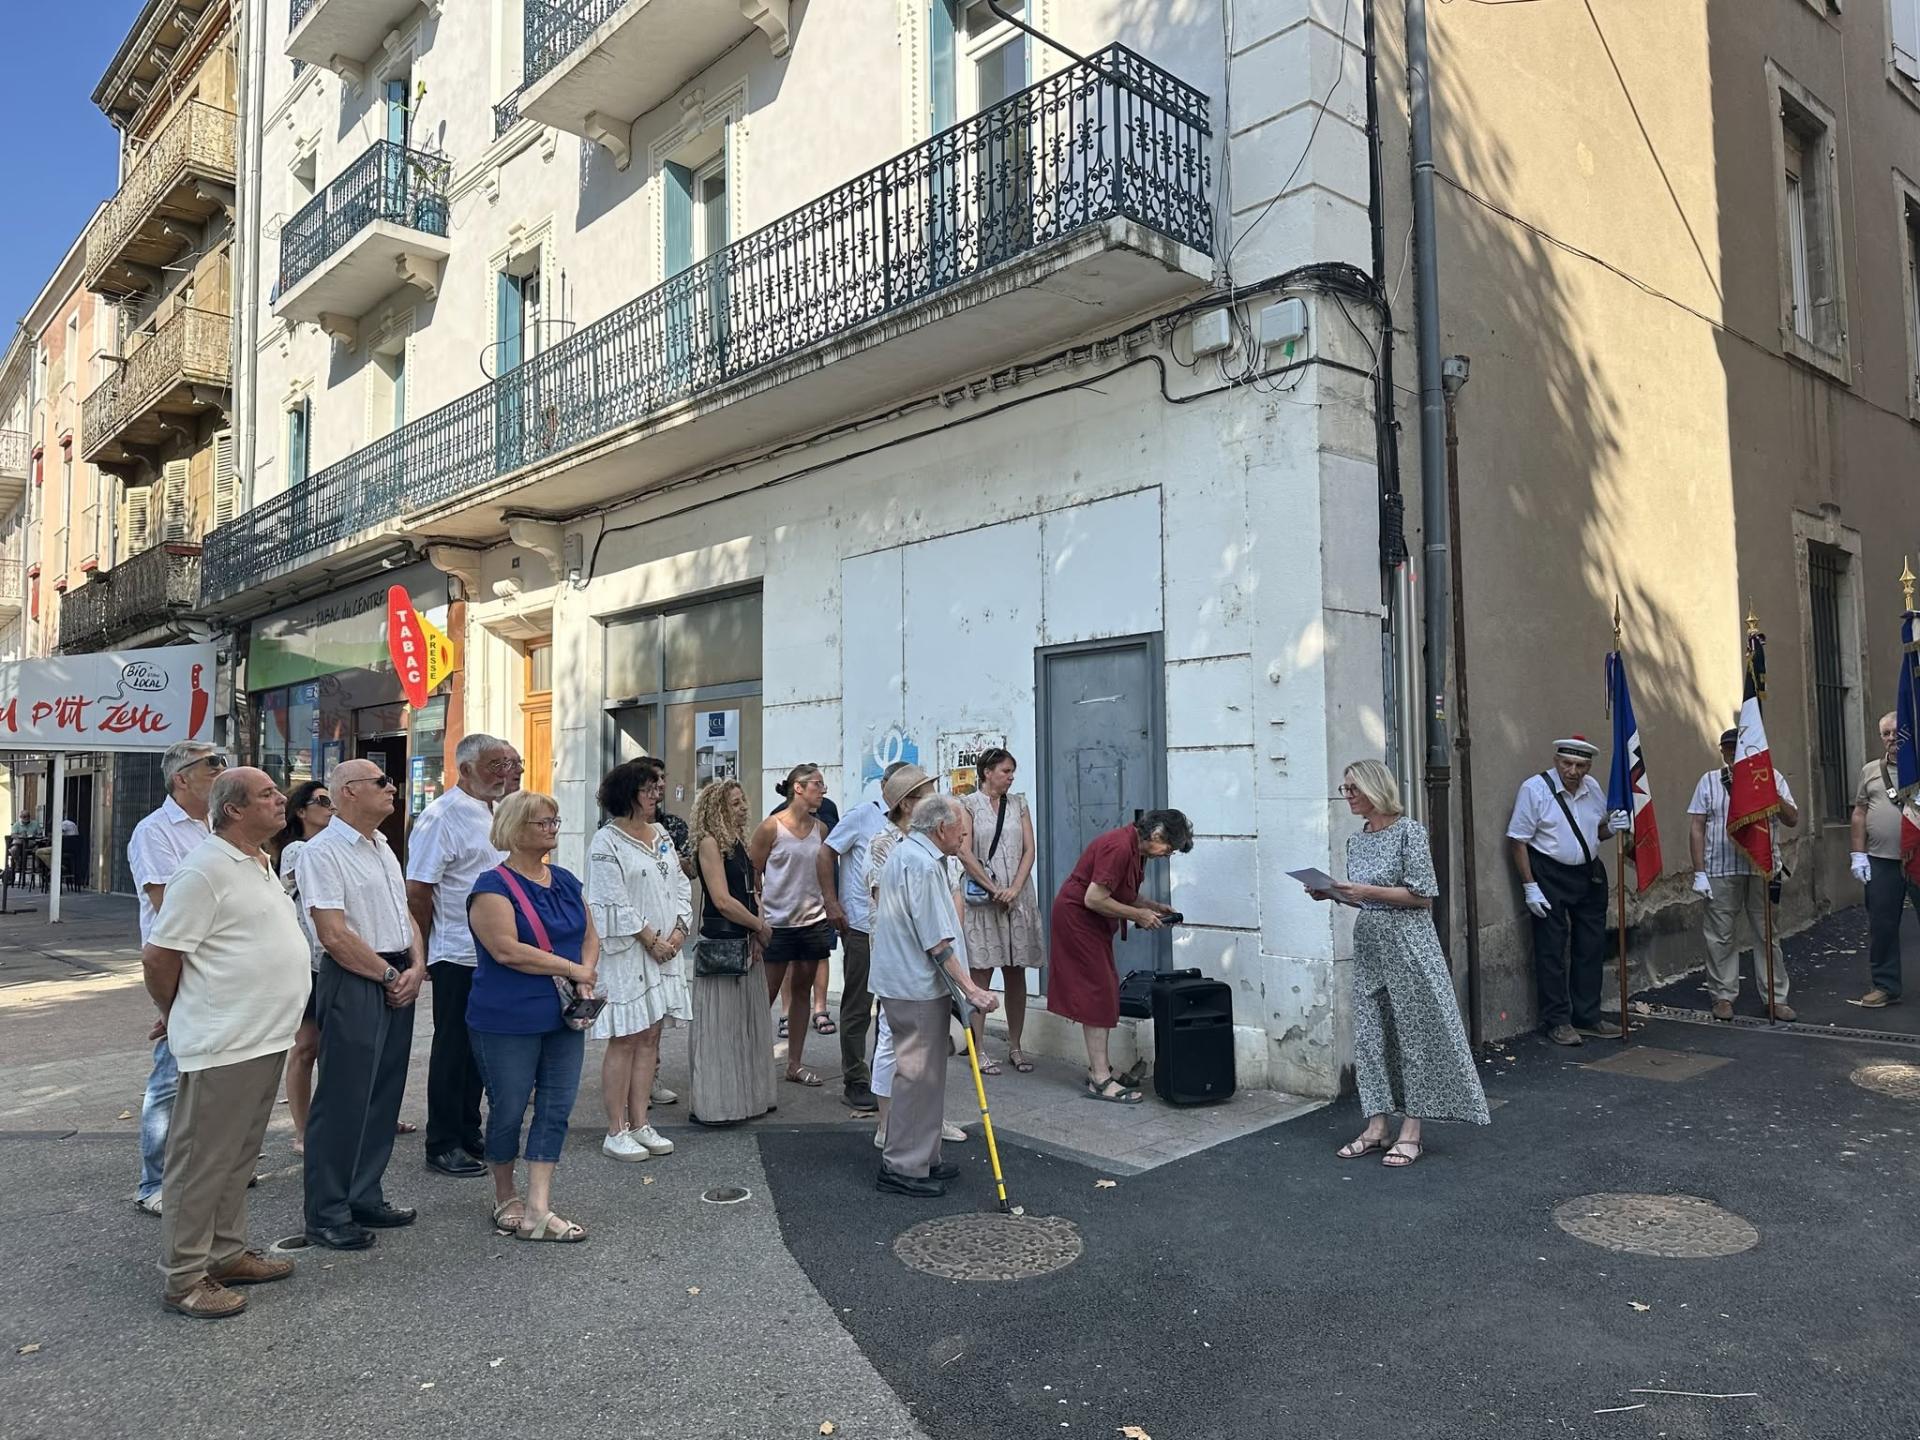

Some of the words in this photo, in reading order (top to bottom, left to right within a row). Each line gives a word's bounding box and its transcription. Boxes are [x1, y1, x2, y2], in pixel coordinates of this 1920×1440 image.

[342, 600, 351, 619] du
[352, 588, 387, 617] CENTRE
[396, 609, 421, 684] TABAC
[429, 633, 437, 680] PRESSE
[133, 677, 162, 688] LOCAL
[97, 700, 172, 734] Zeste
